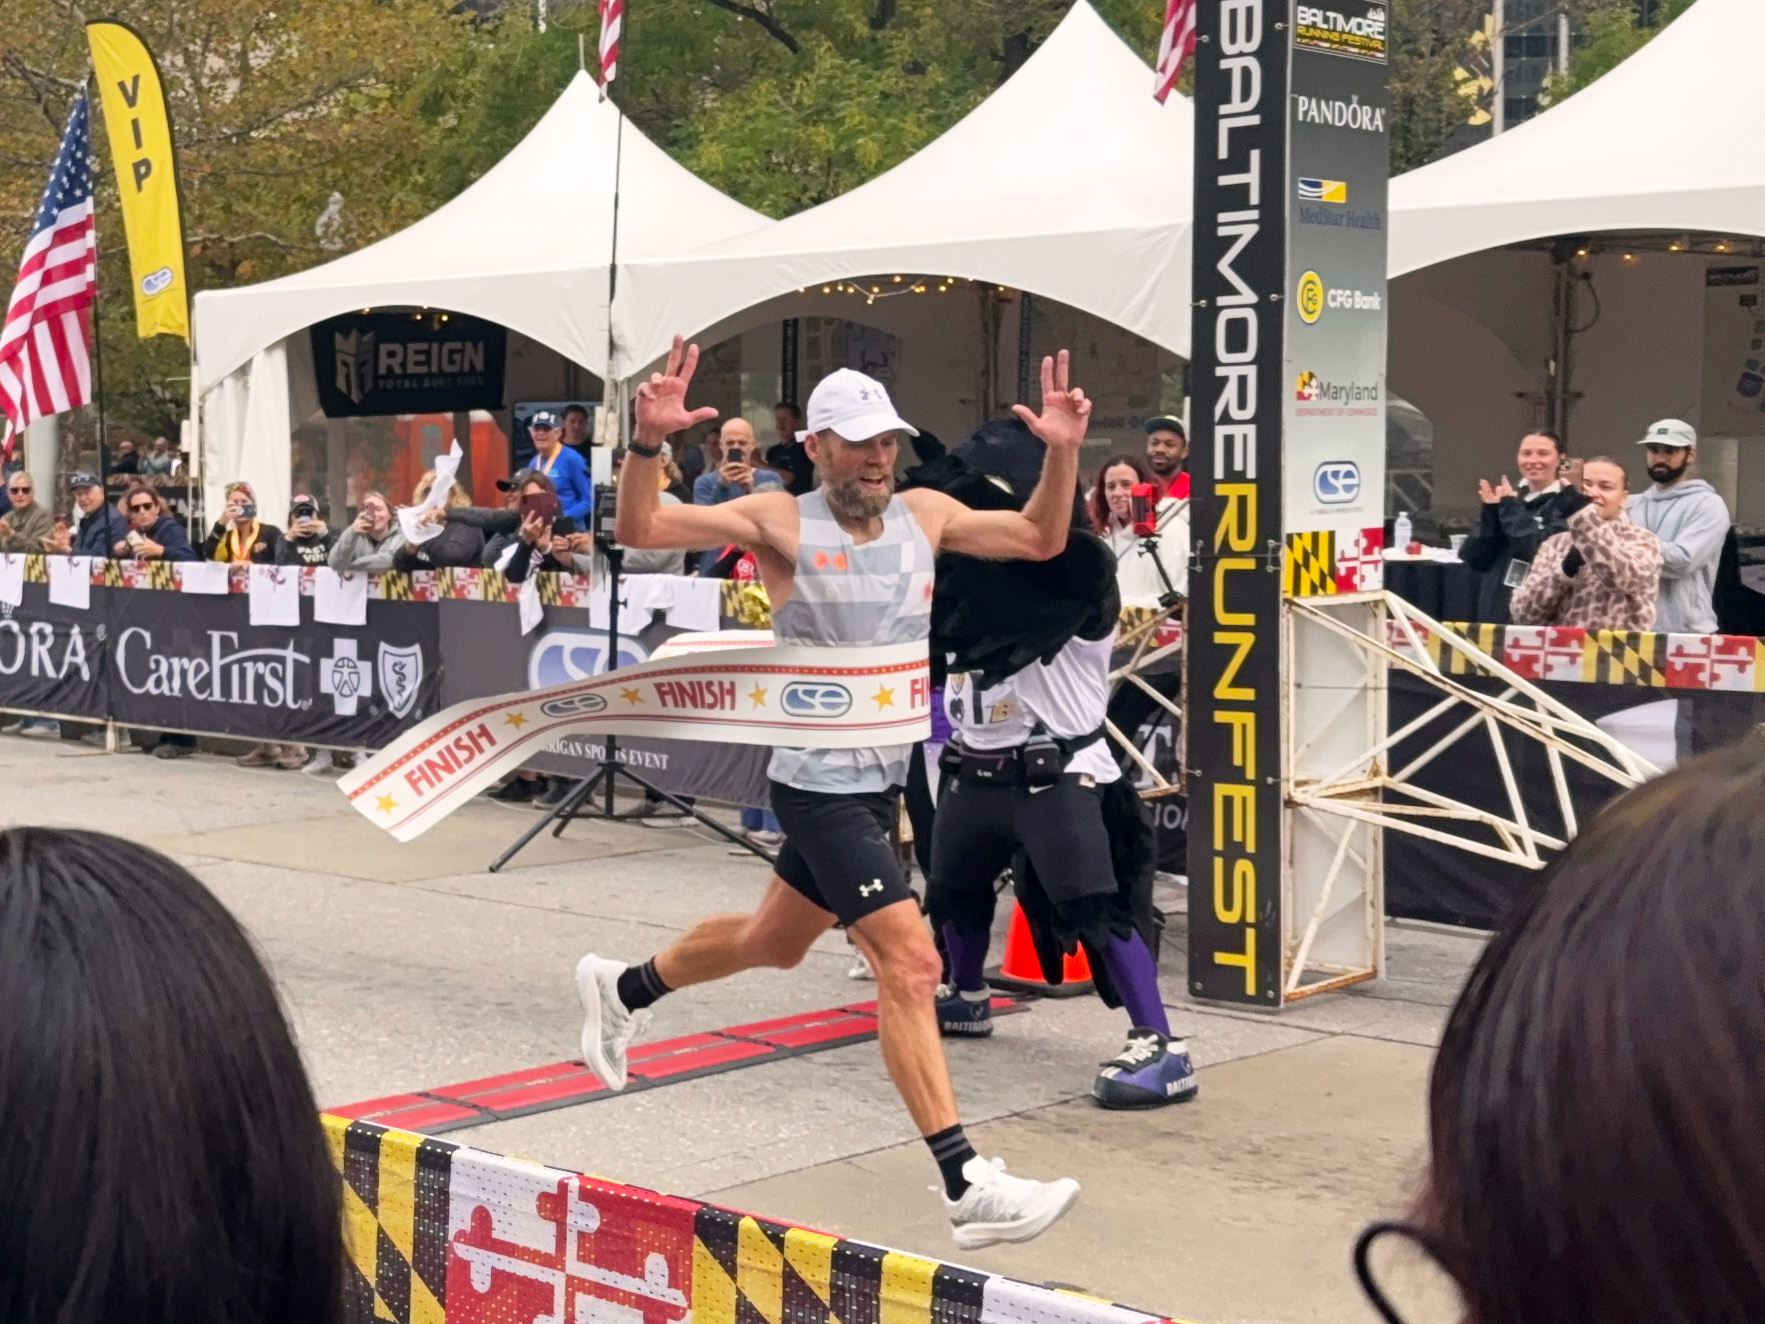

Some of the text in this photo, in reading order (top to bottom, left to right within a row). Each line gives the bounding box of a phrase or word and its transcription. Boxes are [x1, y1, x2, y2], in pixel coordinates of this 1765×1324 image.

[1296, 5, 1385, 41] BALTIMORE
[1296, 26, 1339, 42] RUNNING
[117, 74, 154, 193] VIP
[1327, 288, 1381, 310] CFG Bank
[377, 341, 485, 376] REIGN
[1319, 381, 1378, 406] Maryland
[1213, 0, 1263, 997] BALTIMORE RUNFEST
[116, 626, 310, 709] CareFirst
[653, 681, 736, 710] FINISH
[403, 723, 497, 797] FINISH
[629, 749, 670, 770] EVENT
